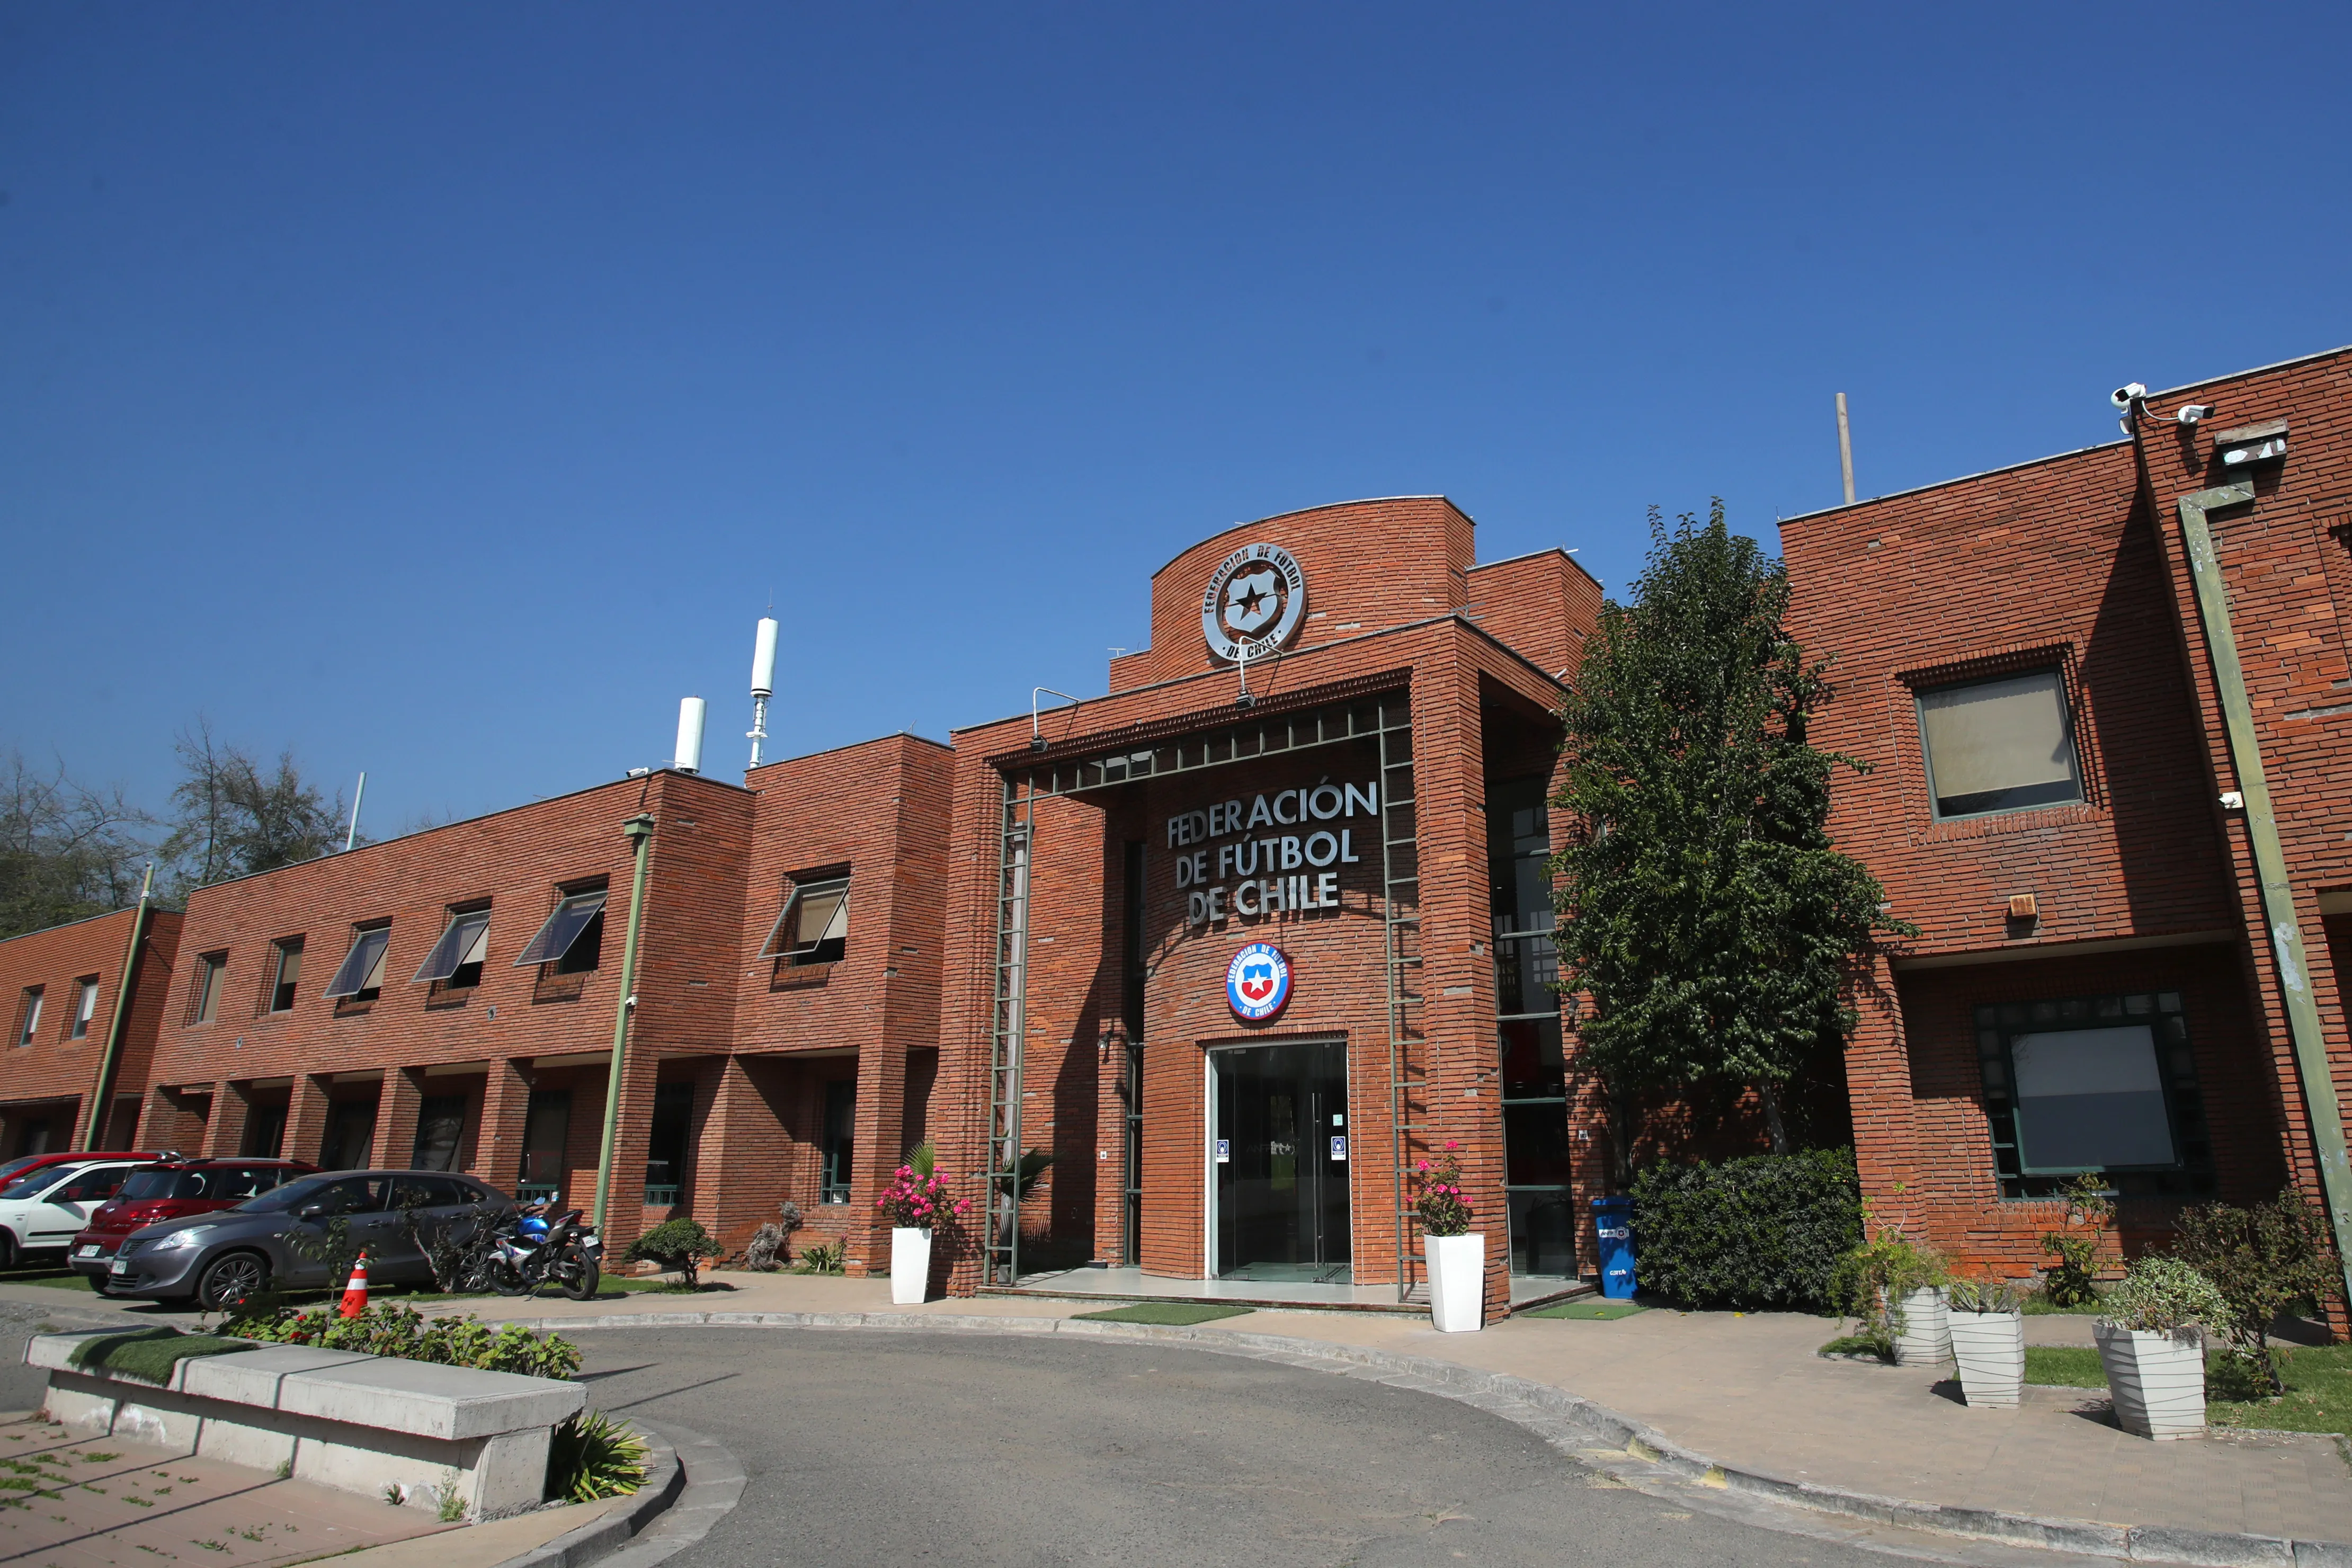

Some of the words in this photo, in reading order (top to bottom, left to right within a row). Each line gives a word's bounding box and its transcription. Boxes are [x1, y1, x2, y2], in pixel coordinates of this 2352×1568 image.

[1204, 548, 1250, 614] FEDERACION
[1257, 545, 1271, 558] DE
[1274, 550, 1302, 592] FUTBOL
[1226, 645, 1241, 658] DE
[1247, 634, 1278, 657] CHILE
[1168, 776, 1378, 849] FEDERACIÓN
[1176, 850, 1207, 889] DE
[1219, 833, 1359, 879] FÚTBOL
[1189, 886, 1228, 925] DE
[1235, 872, 1339, 916] CHILE
[1227, 945, 1257, 983] FEDERACION
[1261, 944, 1270, 954] DE
[1271, 950, 1288, 978] FUTBOL
[1242, 1005, 1252, 1016] DE
[1255, 1003, 1275, 1017] CHILE
